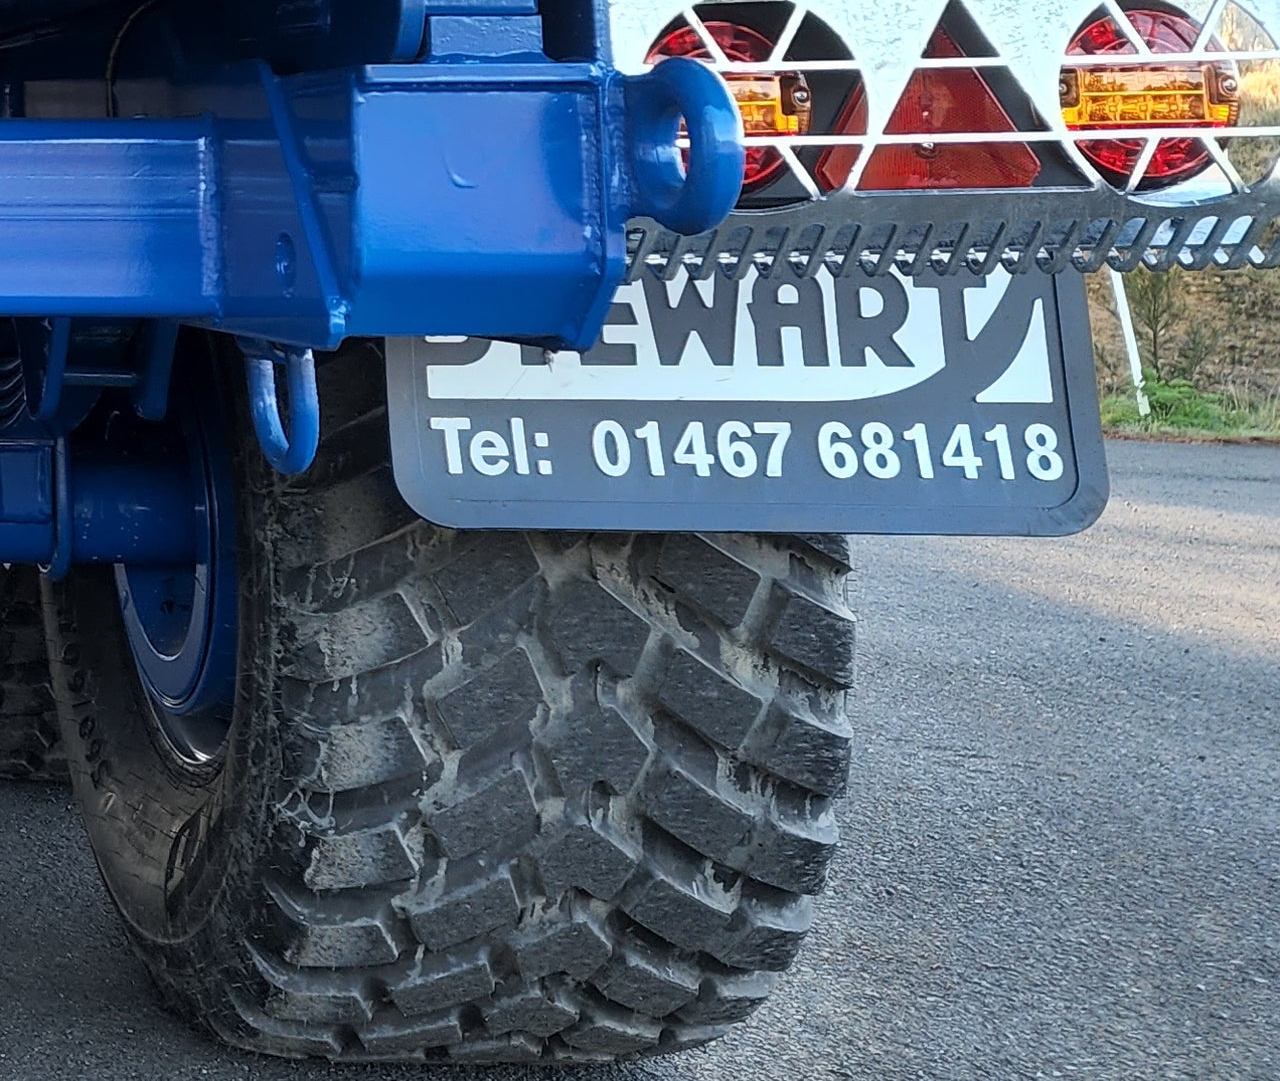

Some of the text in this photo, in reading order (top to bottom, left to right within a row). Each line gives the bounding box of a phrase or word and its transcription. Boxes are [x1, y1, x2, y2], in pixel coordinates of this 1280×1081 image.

[425, 272, 1028, 369] EWART
[430, 416, 1065, 481] Tel: 01467 681418
